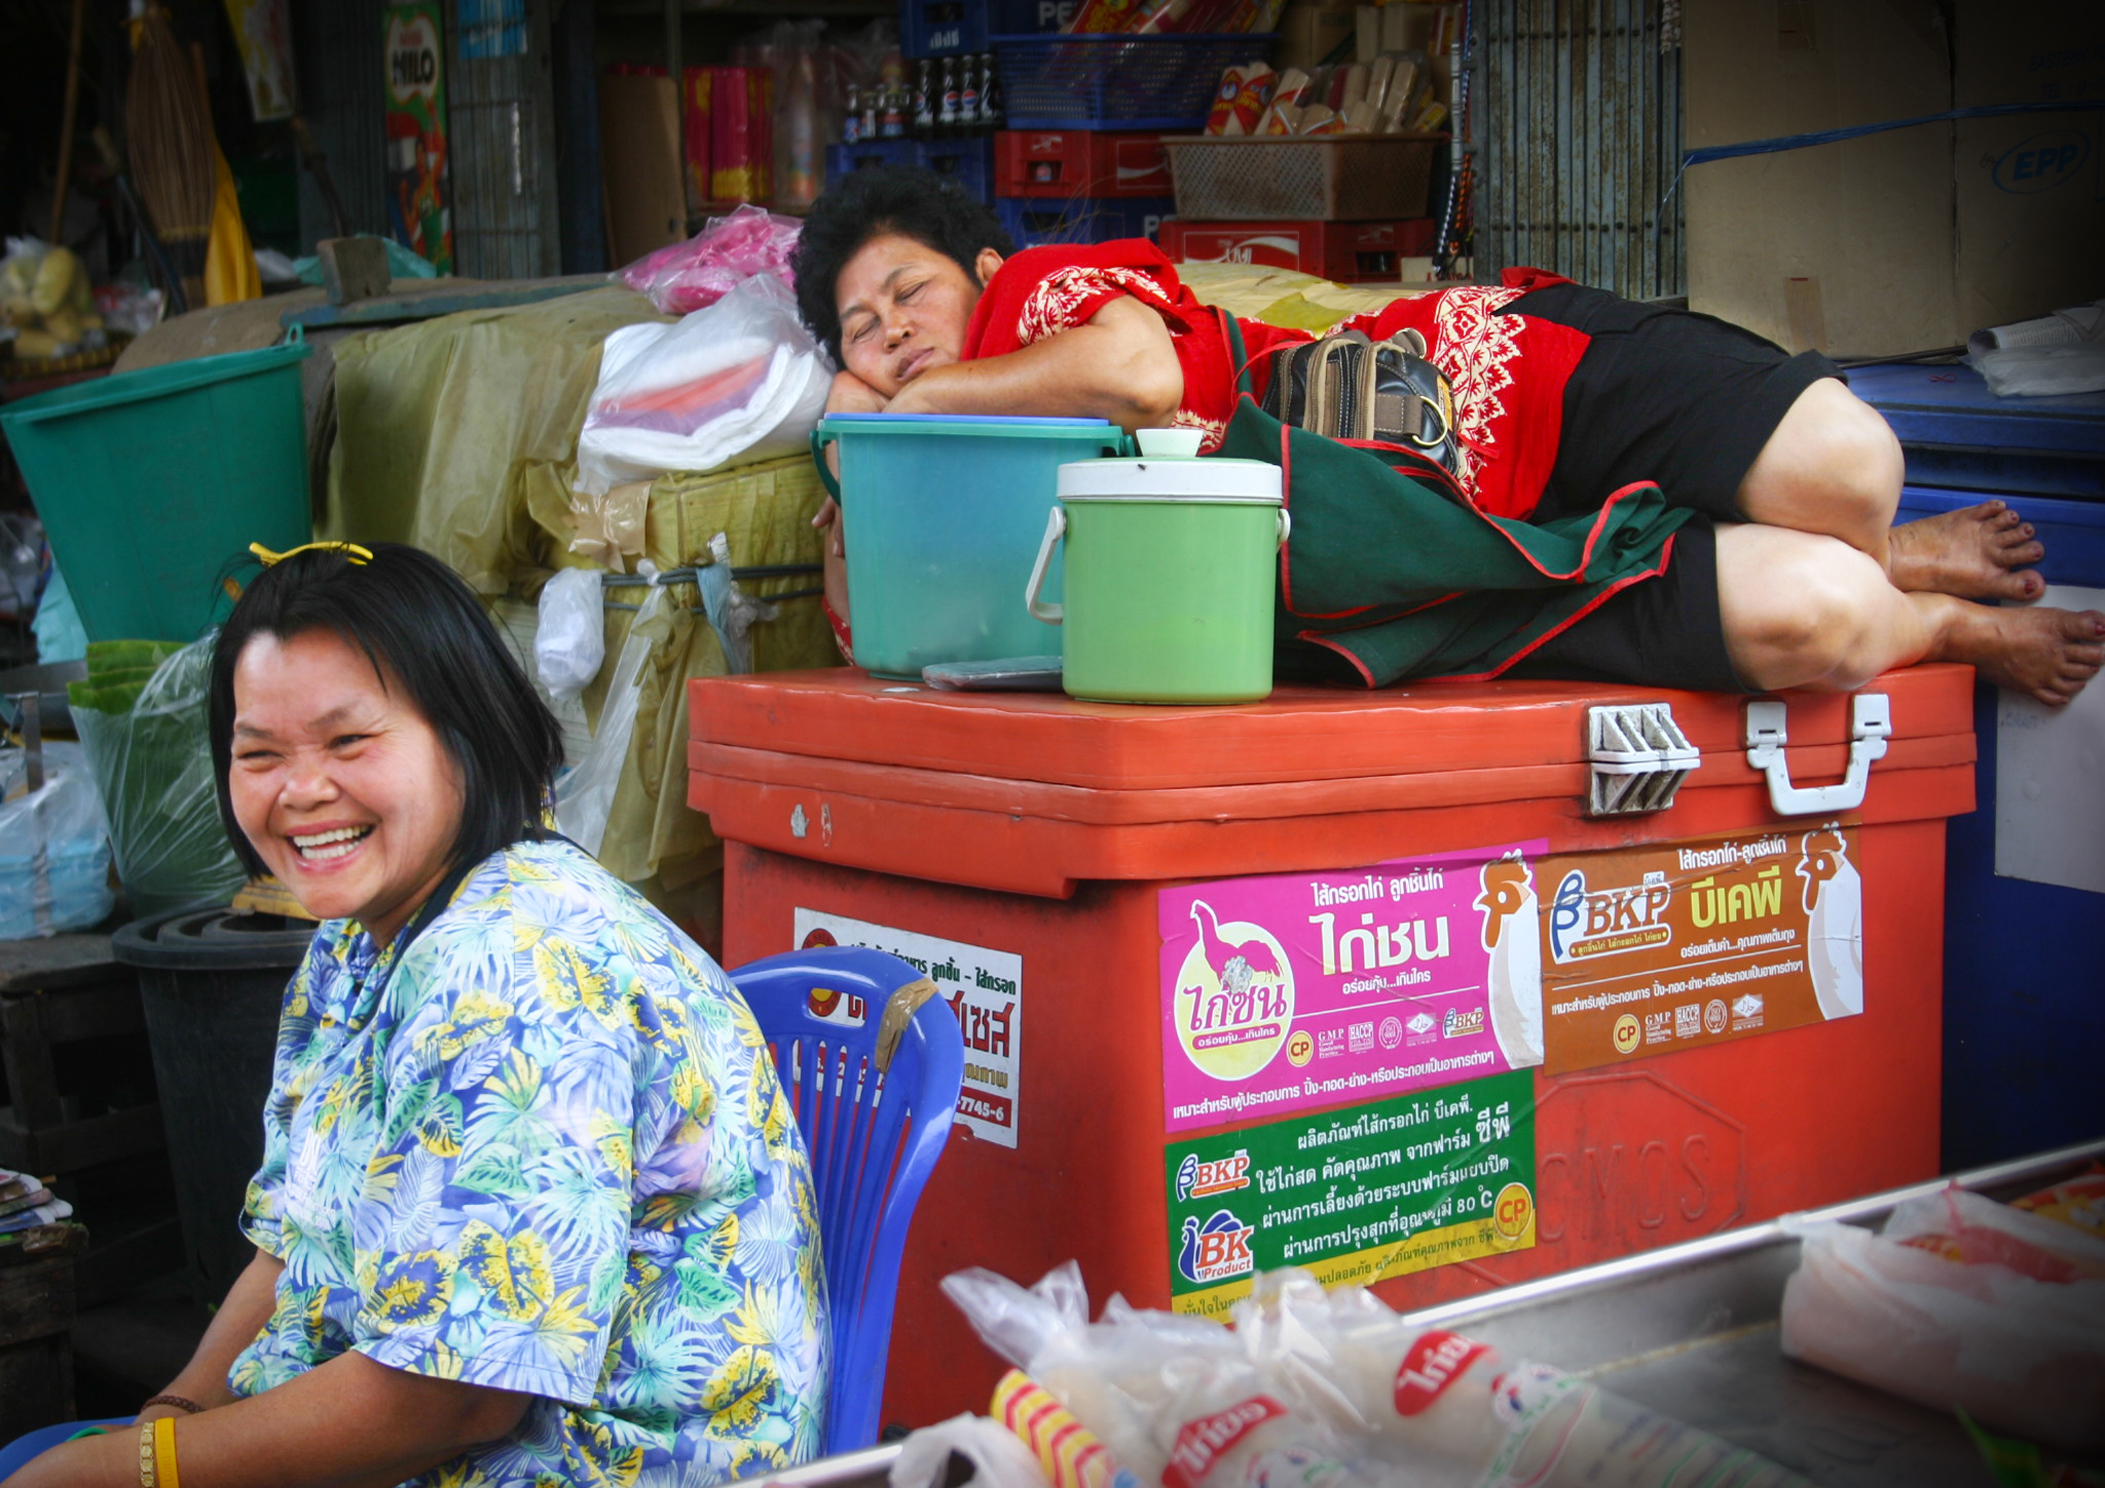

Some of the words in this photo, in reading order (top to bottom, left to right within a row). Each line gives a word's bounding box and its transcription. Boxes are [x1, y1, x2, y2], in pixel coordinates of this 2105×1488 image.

[393, 47, 434, 84] MILO
[2013, 143, 2079, 180] EPP
[1310, 875, 1384, 907] ไส้กรอกไก่
[1691, 865, 1782, 928] บีเคพี
[1584, 885, 1669, 936] BKP
[1308, 912, 1450, 976] ไก่ชน
[1291, 1041, 1310, 1057] CP
[1618, 1026, 1636, 1043] CP
[1173, 1086, 1299, 1119] เหมาะสำหรับผู้ประกอบการ
[1297, 1103, 1430, 1150] ผลิตภัณฑ์ไส้กรอกไก่
[1255, 1166, 1317, 1193] ใช้ไก่สด
[1475, 1101, 1510, 1143] ซีพี
[1196, 1157, 1248, 1187] BKP
[1457, 1197, 1476, 1213] 80
[1500, 1198, 1526, 1223] CP
[1196, 1228, 1253, 1269] BK
[1203, 1259, 1251, 1279] Product
[1397, 1335, 1470, 1391] ไก่ย
